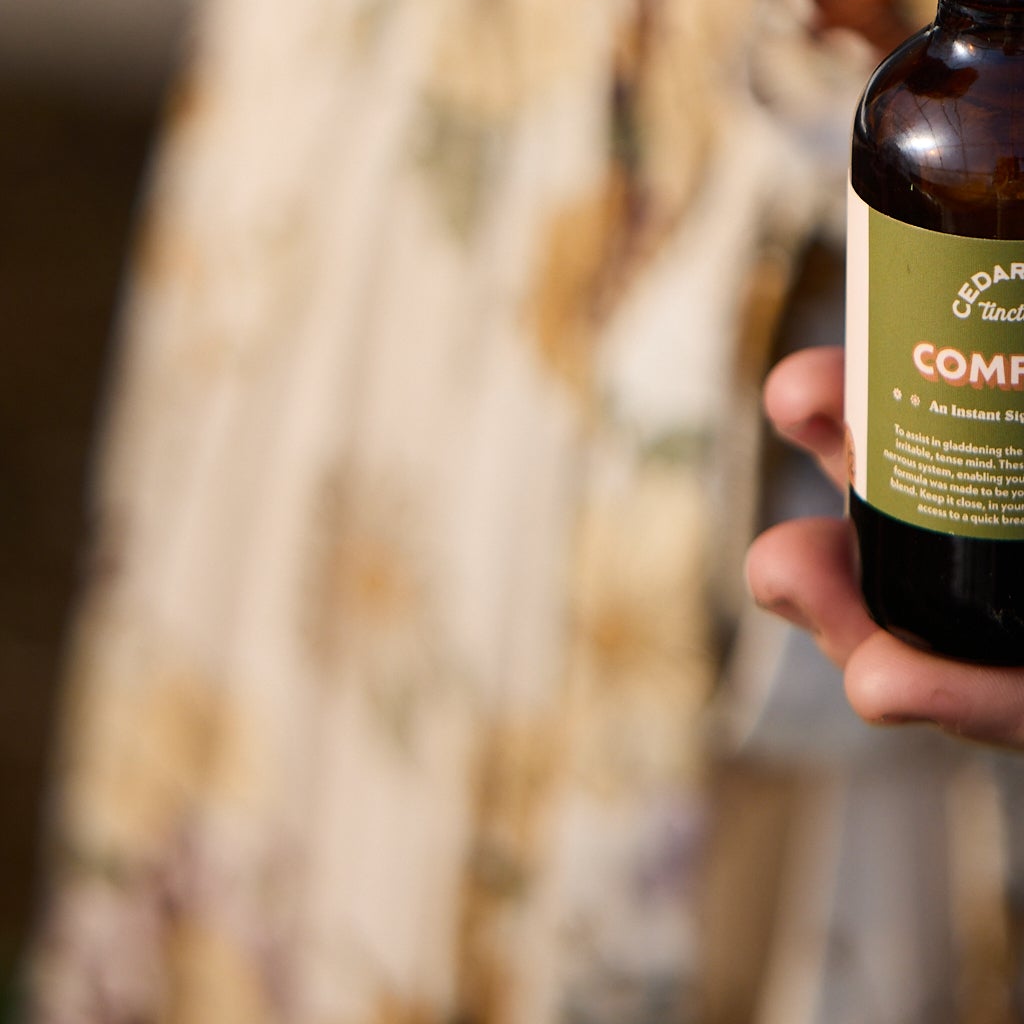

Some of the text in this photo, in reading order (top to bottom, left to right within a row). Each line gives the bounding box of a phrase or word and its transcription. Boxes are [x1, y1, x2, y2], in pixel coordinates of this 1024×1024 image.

[929, 400, 948, 415] An
[951, 404, 1001, 422] Instant
[895, 423, 905, 436] To
[905, 430, 930, 446] assist
[931, 436, 941, 448] in
[942, 440, 1003, 458] gladdening
[1004, 445, 1023, 456] the
[895, 437, 934, 462] irritable,
[935, 452, 964, 466] tense
[965, 458, 997, 469] mind.
[883, 448, 917, 469] nervous
[917, 462, 955, 480] system,
[956, 471, 1003, 486] enabling
[893, 464, 928, 486] formula
[929, 478, 948, 491] was
[949, 483, 979, 496] made
[980, 487, 993, 497] to
[994, 487, 1009, 497] be
[890, 476, 919, 497] blend.
[919, 487, 945, 505] Keep
[946, 494, 955, 506] it
[956, 497, 987, 511] close,
[988, 499, 999, 511] in
[917, 503, 948, 519] access
[948, 510, 961, 521] to
[961, 513, 969, 522] a
[970, 513, 1000, 526] quick
